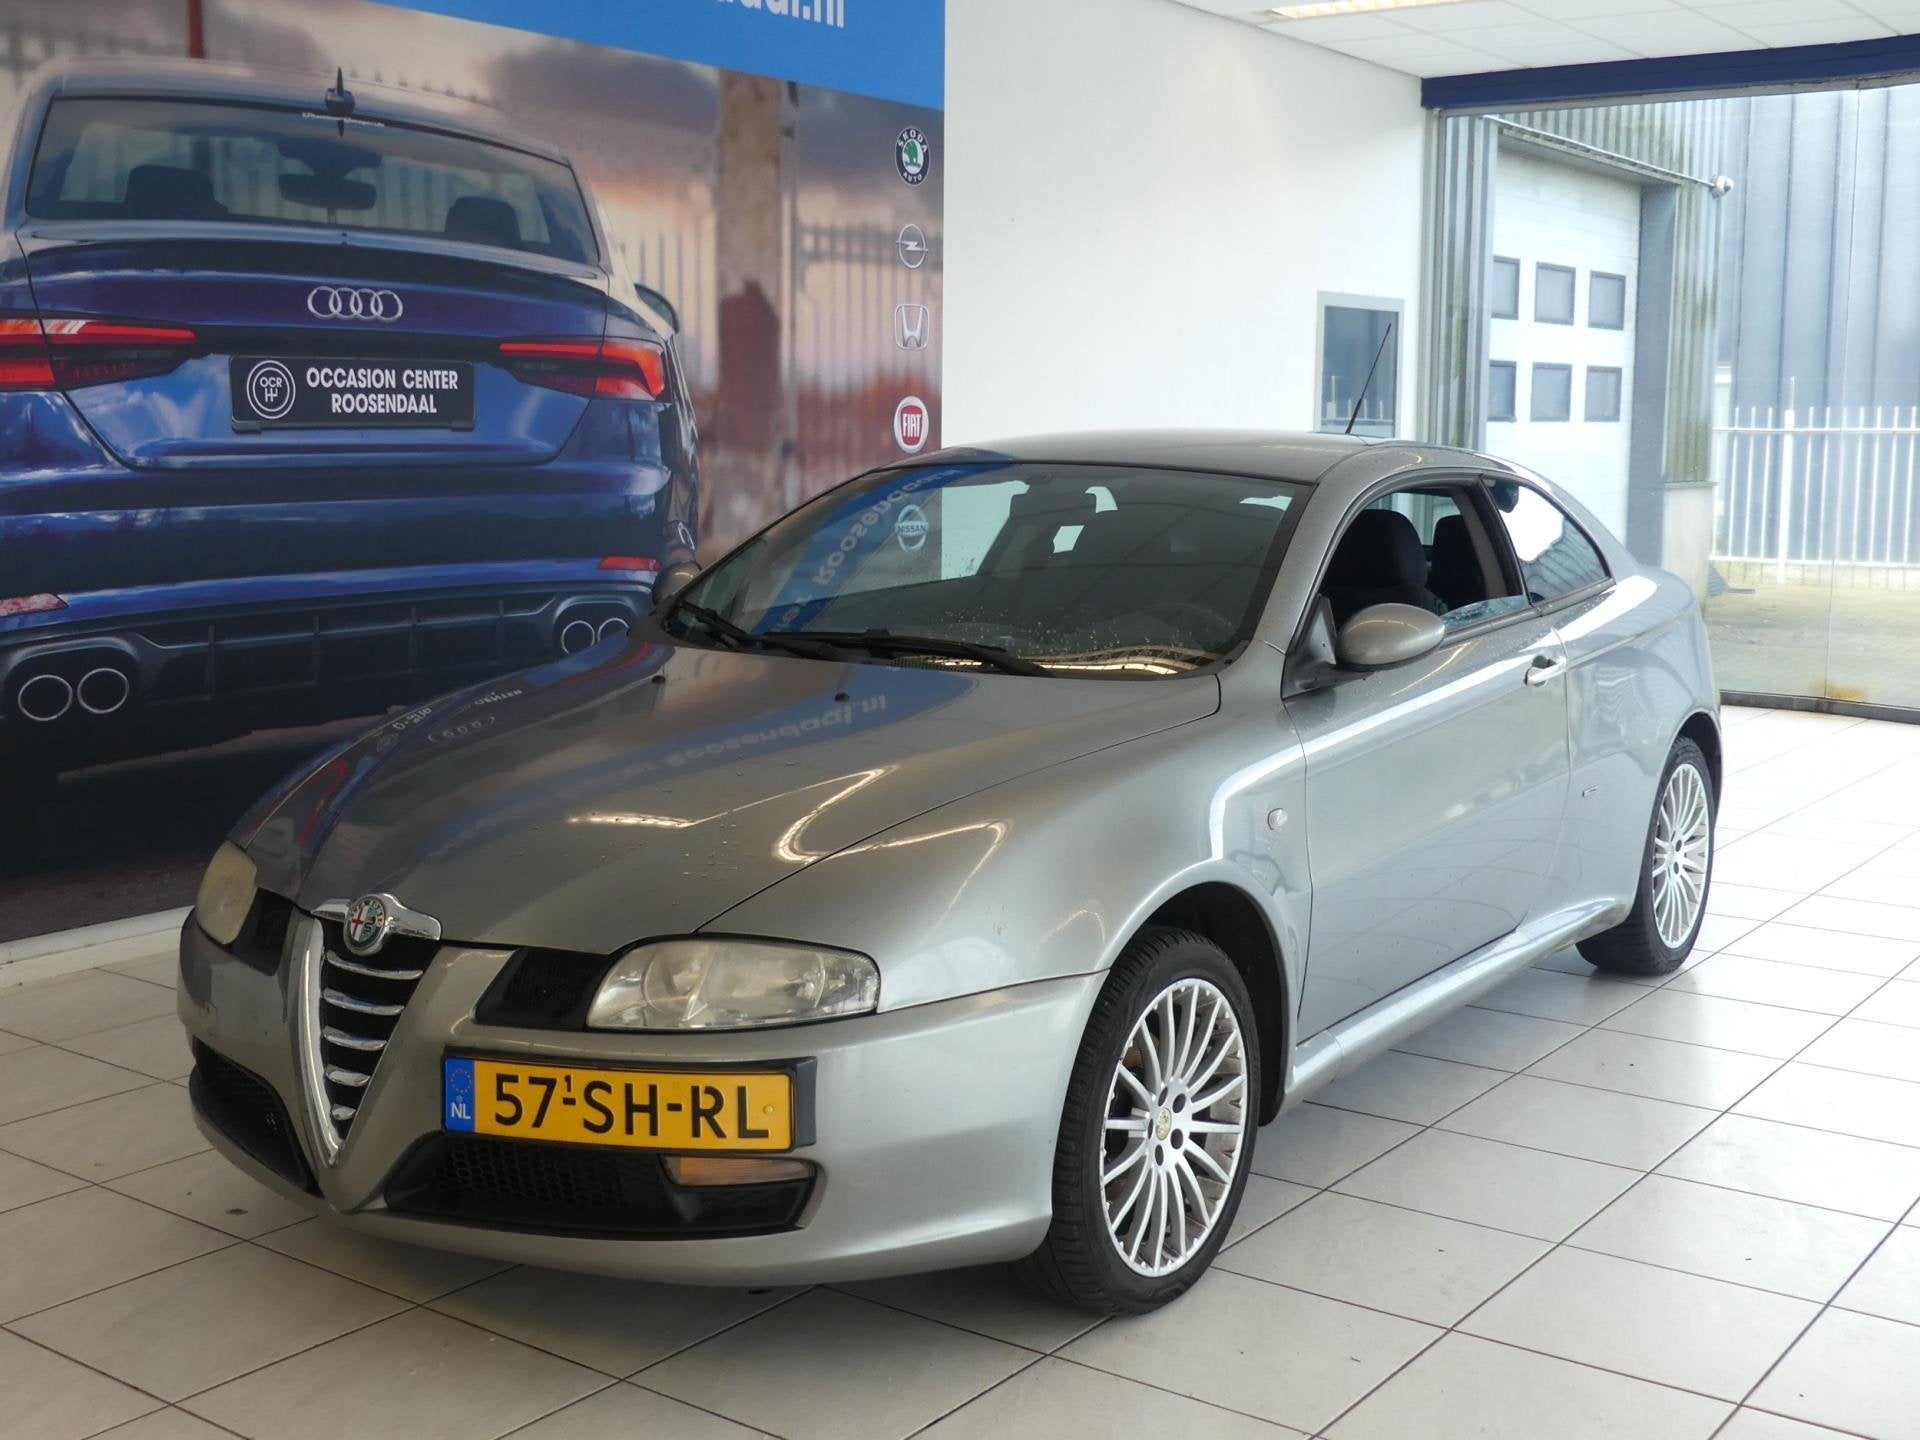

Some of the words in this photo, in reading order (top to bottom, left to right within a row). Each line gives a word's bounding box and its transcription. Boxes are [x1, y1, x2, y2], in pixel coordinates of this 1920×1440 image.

[903, 172, 923, 182] AUTO
[259, 375, 283, 389] OCR
[306, 367, 396, 389] OCCASION
[402, 369, 458, 390] CENTER
[331, 393, 437, 414] ROOSENDAAL
[902, 413, 922, 437] FIAT
[896, 523, 927, 533] NISSAN
[451, 1102, 472, 1120] NL
